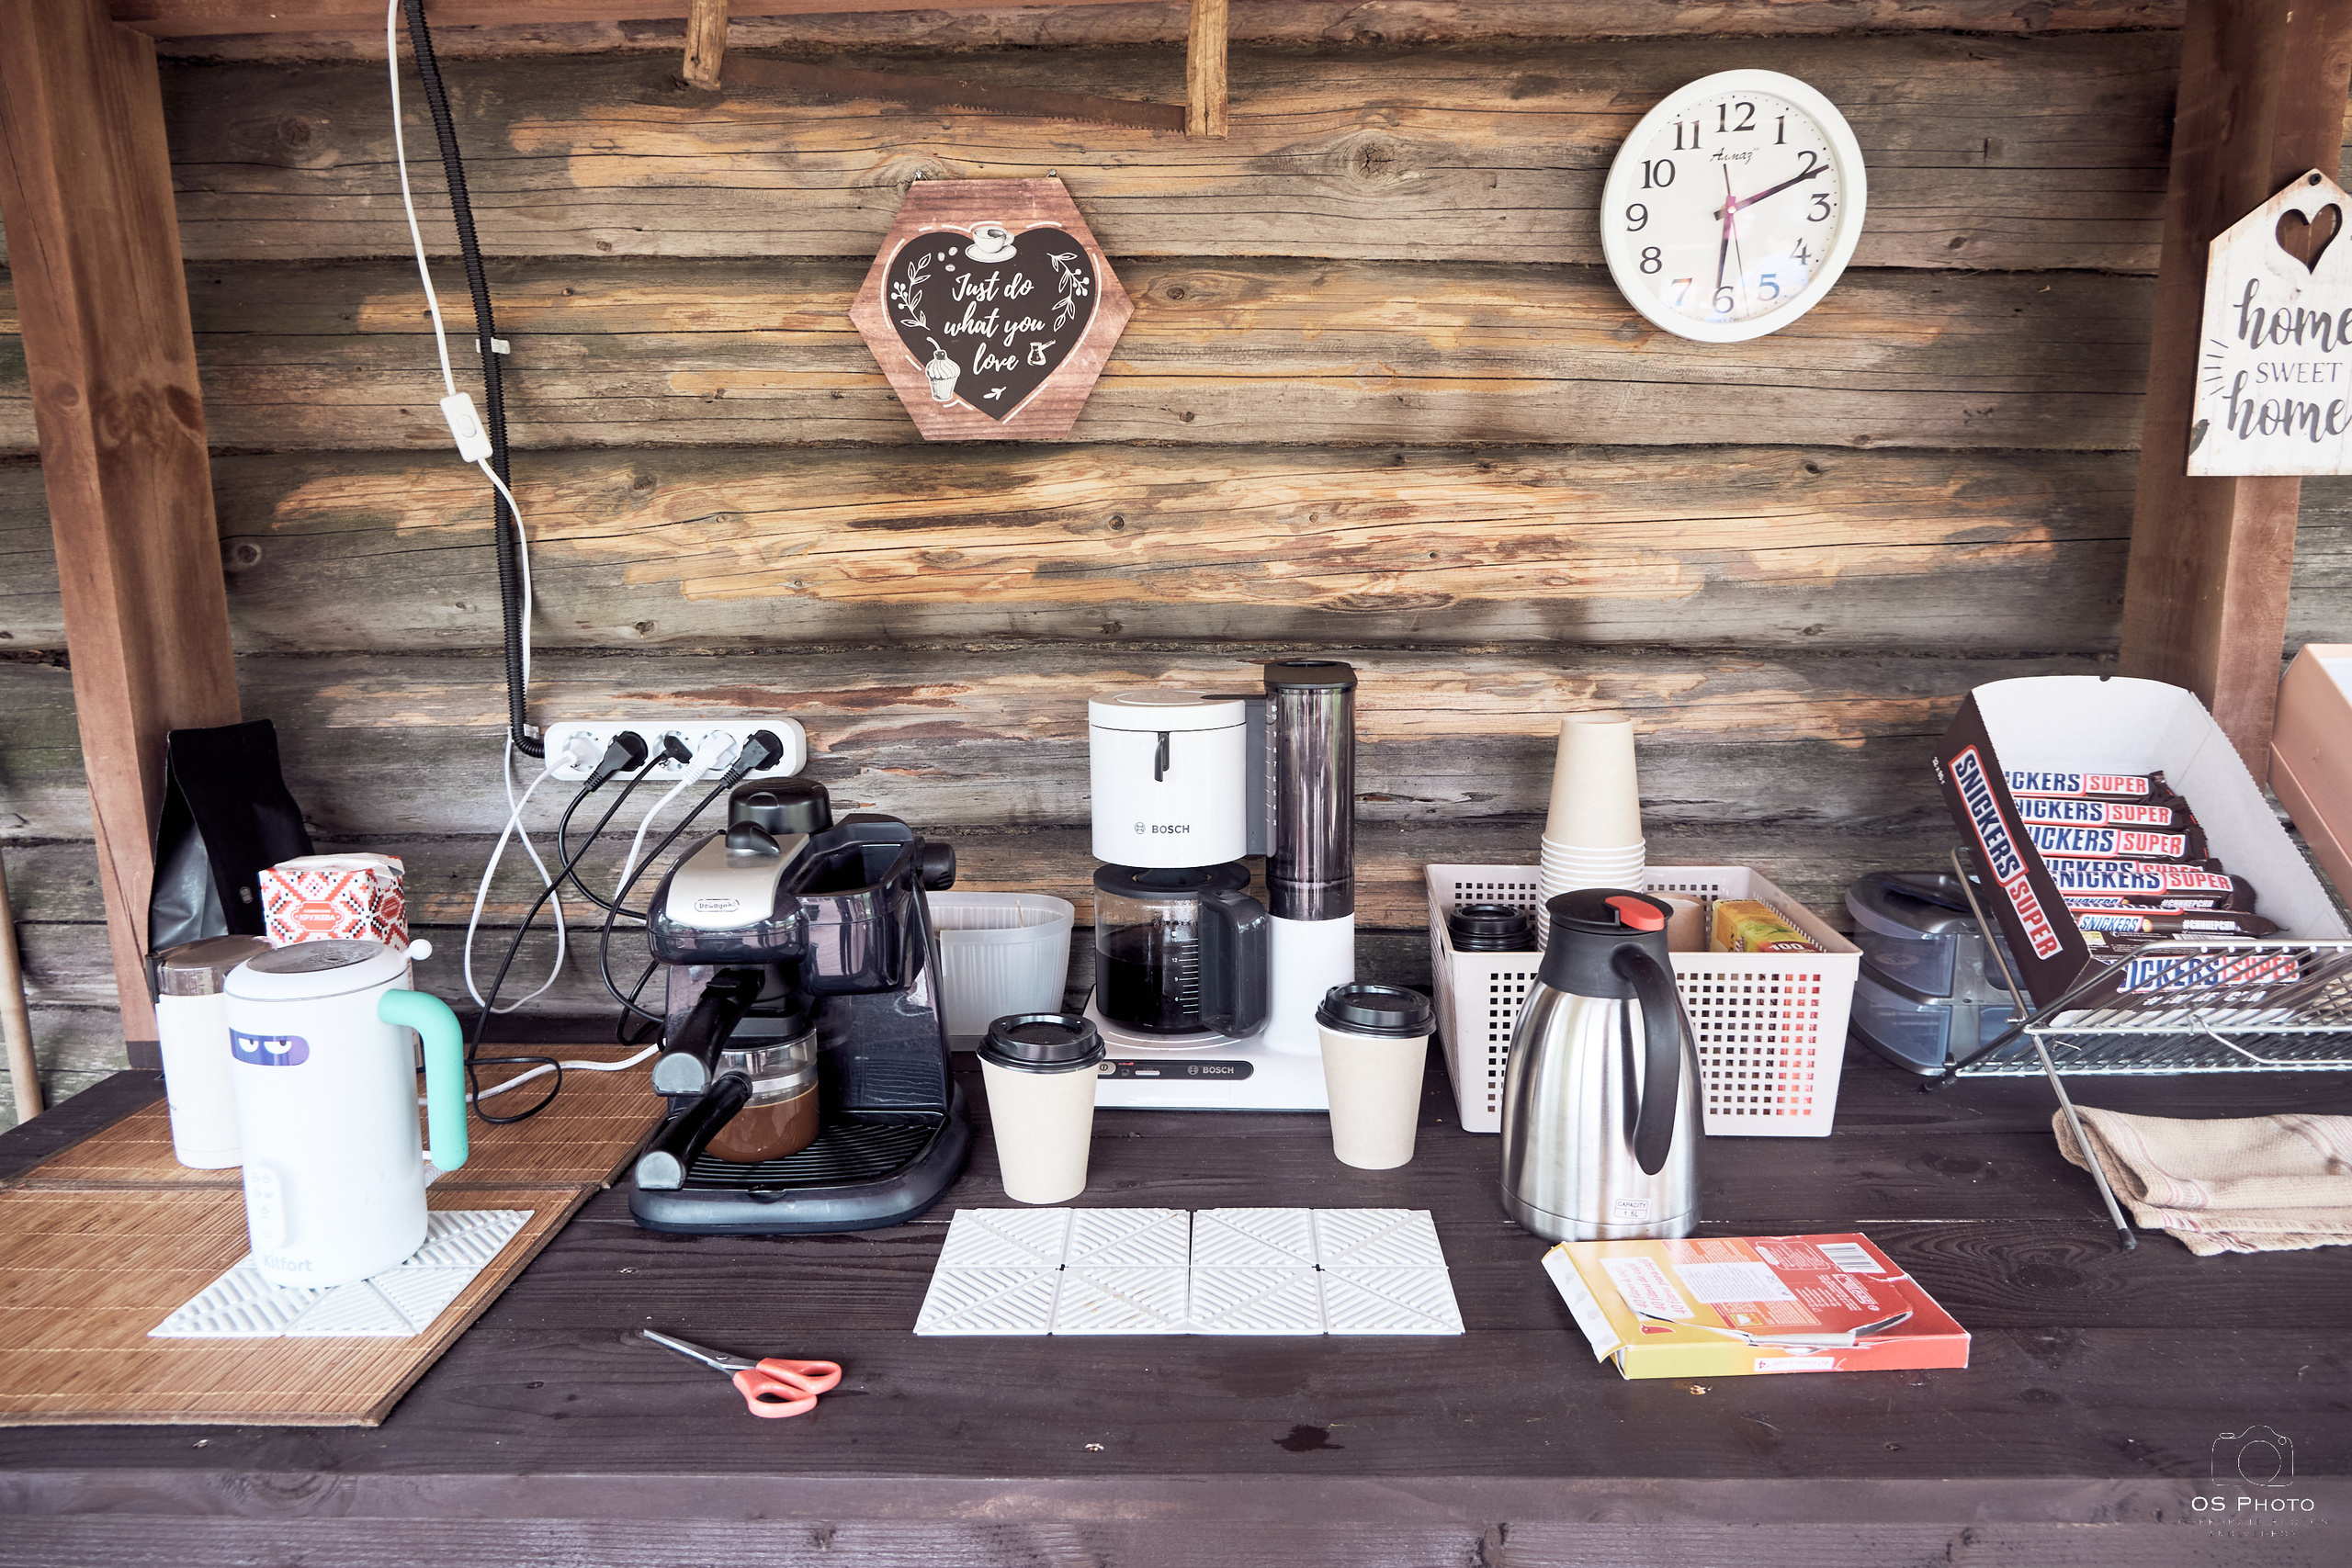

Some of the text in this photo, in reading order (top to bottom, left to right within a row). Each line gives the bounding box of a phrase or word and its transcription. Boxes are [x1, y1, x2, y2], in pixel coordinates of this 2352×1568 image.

[1715, 102, 1756, 133] 12
[1773, 115, 1787, 145] 1
[1672, 120, 1702, 151] 11
[1640, 159, 1676, 189] 10
[1796, 151, 1818, 179] 2
[1625, 203, 1648, 231] 9
[1806, 193, 1831, 222] 3
[1639, 246, 1663, 275] 8
[1789, 237, 1812, 265] 4
[952, 270, 1035, 302] Just do
[1670, 277, 1693, 307] 7
[1712, 286, 1735, 314] 6
[1757, 273, 1781, 301] 5
[944, 300, 1046, 347] what you
[973, 342, 1019, 376] love
[2256, 362, 2343, 383] SWEET
[2222, 369, 2352, 444] home
[2090, 775, 2146, 793] SUPER
[2113, 805, 2169, 823] SUPER
[1151, 825, 1190, 834] BOSCH
[2025, 827, 2180, 854] ICKERS SUPER
[1955, 753, 2058, 957] SNICKERS SUPER
[2169, 873, 2231, 889] SUPER
[2079, 916, 2139, 931] SNICKERS
[264, 1254, 313, 1271] Kitfort
